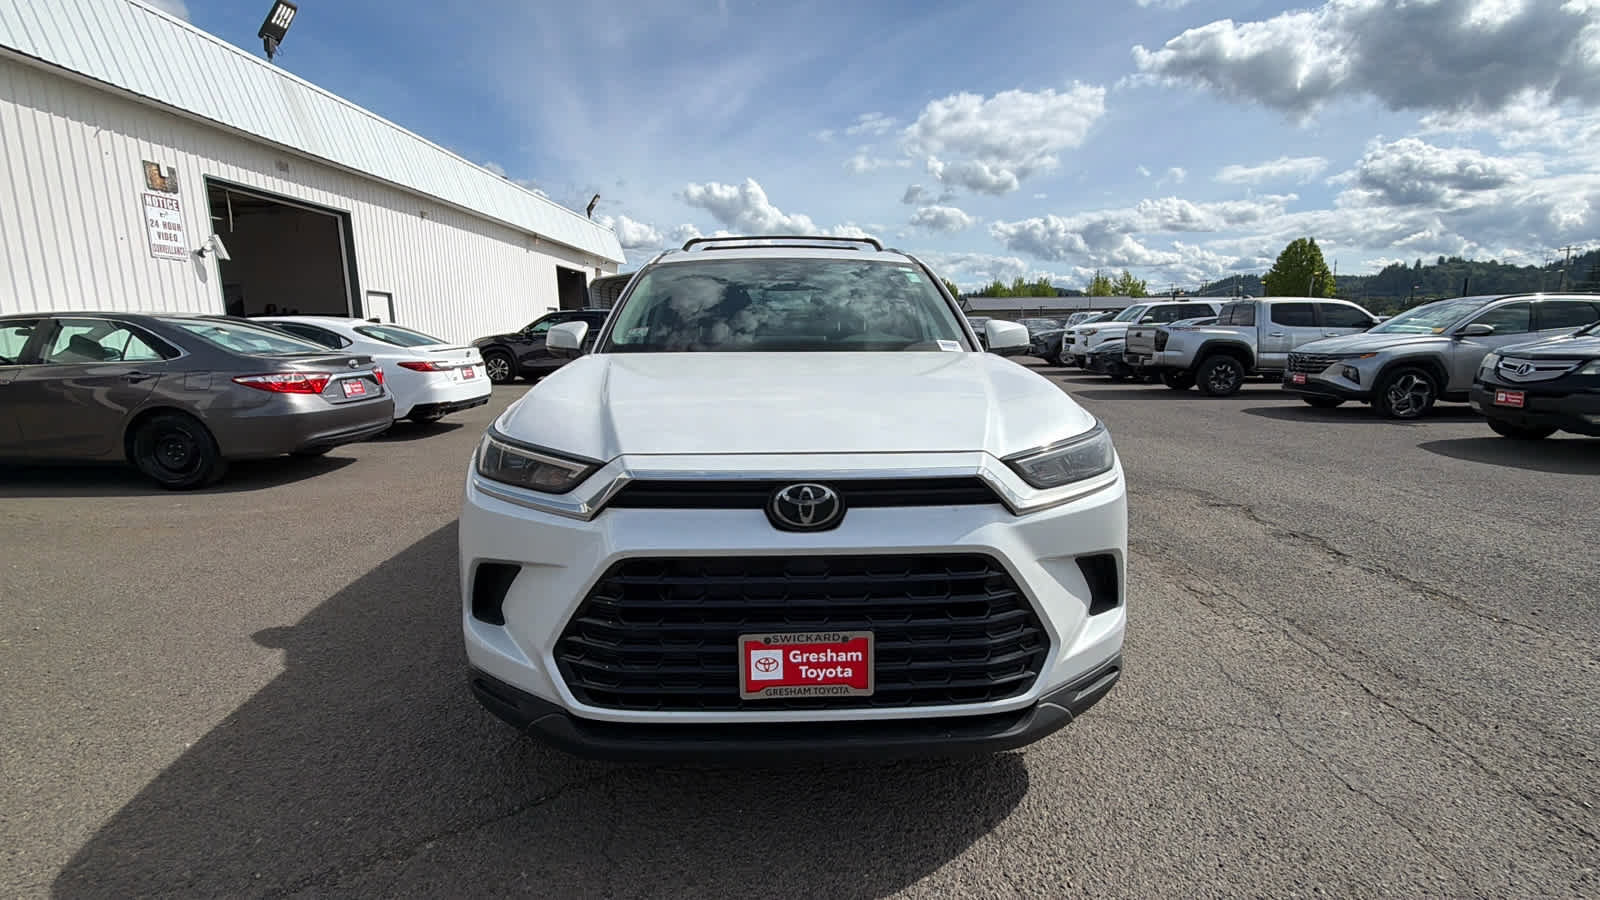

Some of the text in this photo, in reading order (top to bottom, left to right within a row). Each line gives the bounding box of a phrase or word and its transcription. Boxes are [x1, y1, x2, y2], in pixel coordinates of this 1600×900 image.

[144, 194, 179, 210] NOTICE
[149, 219, 182, 232] 24 HOUR
[157, 231, 179, 242] VIDEO
[772, 633, 841, 643] SWICKARD
[789, 648, 863, 663] Gresham
[799, 665, 853, 681] Toyota
[765, 686, 850, 697] GRESHAM TOYOTA
